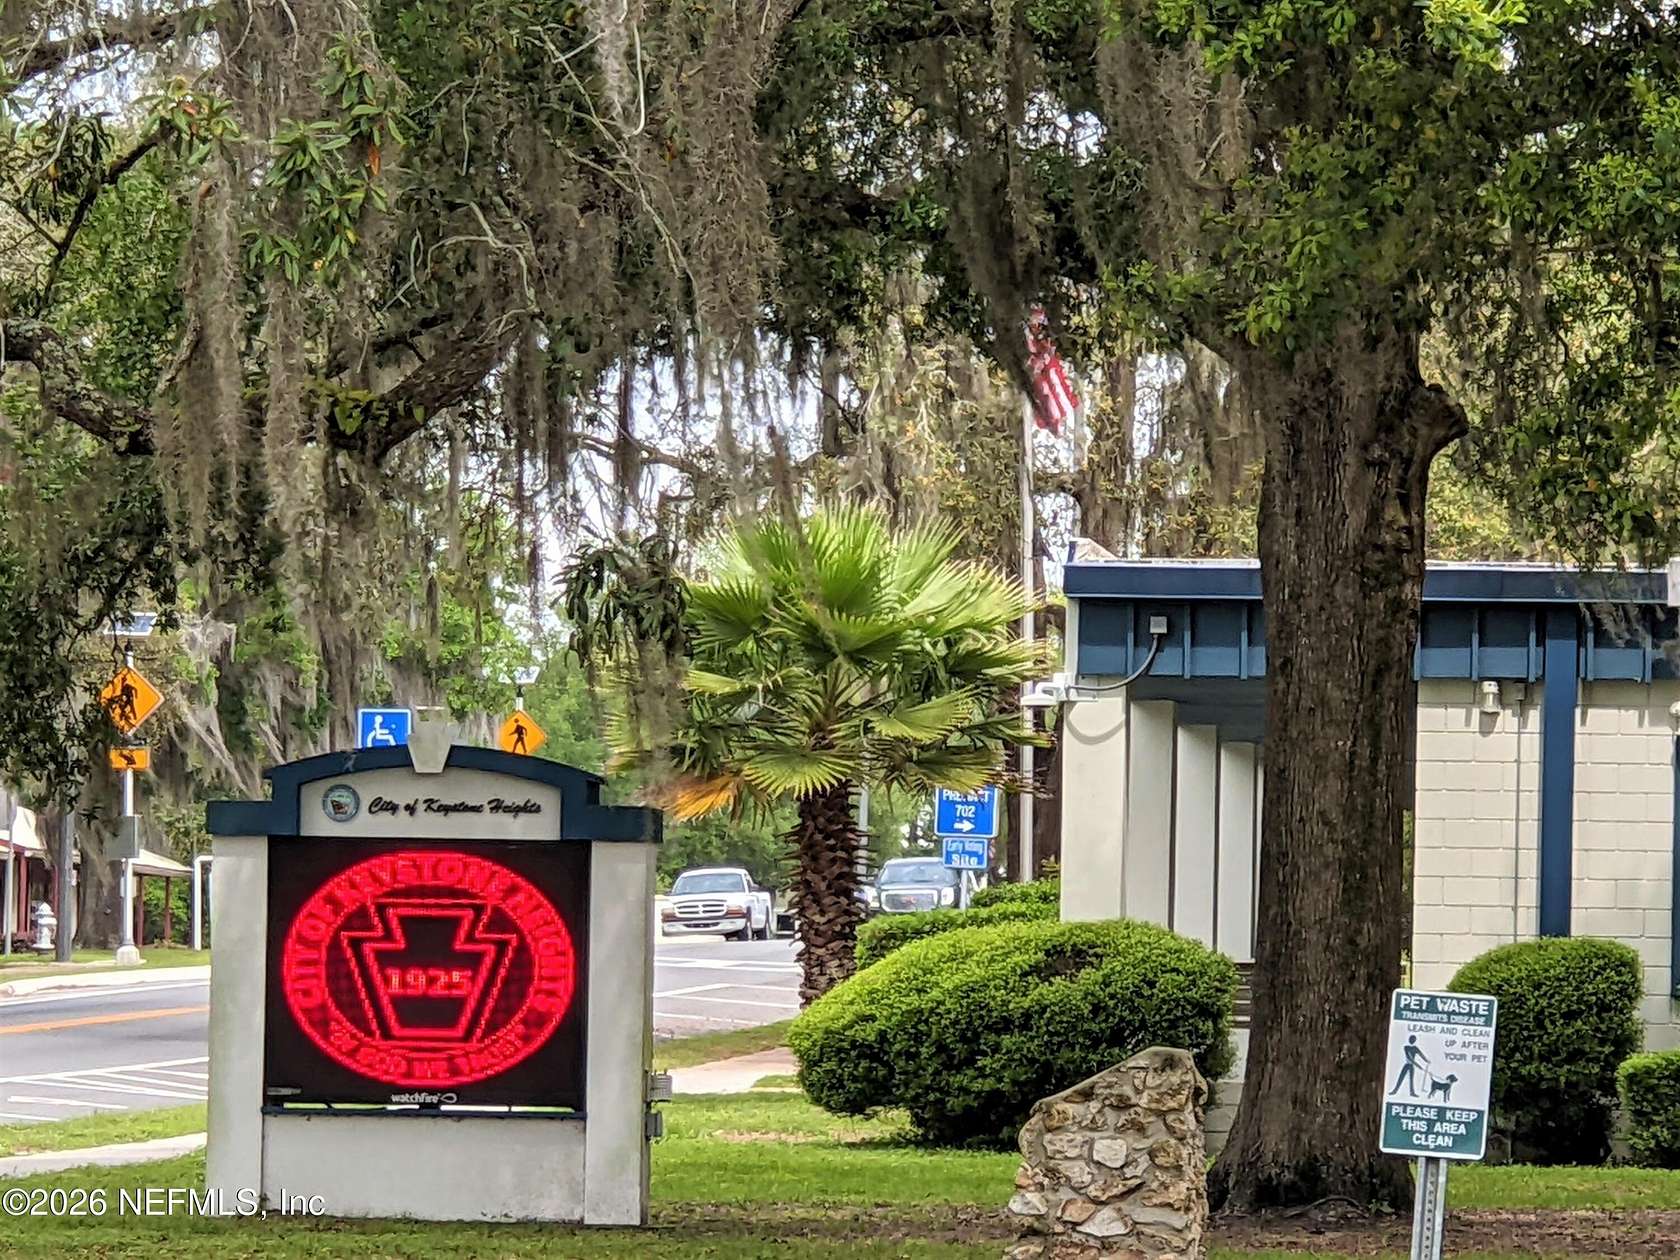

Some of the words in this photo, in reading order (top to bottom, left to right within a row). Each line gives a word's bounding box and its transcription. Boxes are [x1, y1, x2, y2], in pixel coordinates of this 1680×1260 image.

[368, 797, 399, 816] City
[404, 798, 418, 816] of
[422, 798, 483, 816] Keystone
[487, 798, 542, 818] Heights
[954, 804, 976, 818] 702
[385, 966, 473, 996] 1925
[1400, 994, 1430, 1010] PET
[1436, 998, 1490, 1015] WASTE
[1402, 1010, 1448, 1022] TRANSMITS
[1450, 1015, 1486, 1025] DISEASE
[1407, 1023, 1436, 1033] LEASH
[1440, 1026, 1458, 1036] AND
[1461, 1028, 1491, 1038] CLEAN
[1444, 1039, 1457, 1048] UP
[1461, 1041, 1489, 1051] AFTER
[1445, 1052, 1467, 1062] YOUR
[1471, 1054, 1488, 1063] PET
[390, 1091, 441, 1104] watchfire
[1391, 1105, 1438, 1120] PLEASE
[1446, 1109, 1478, 1123] KEEP
[1401, 1119, 1428, 1132] THIS
[1433, 1122, 1467, 1136] AREA
[1412, 1133, 1454, 1148] CLEAN
